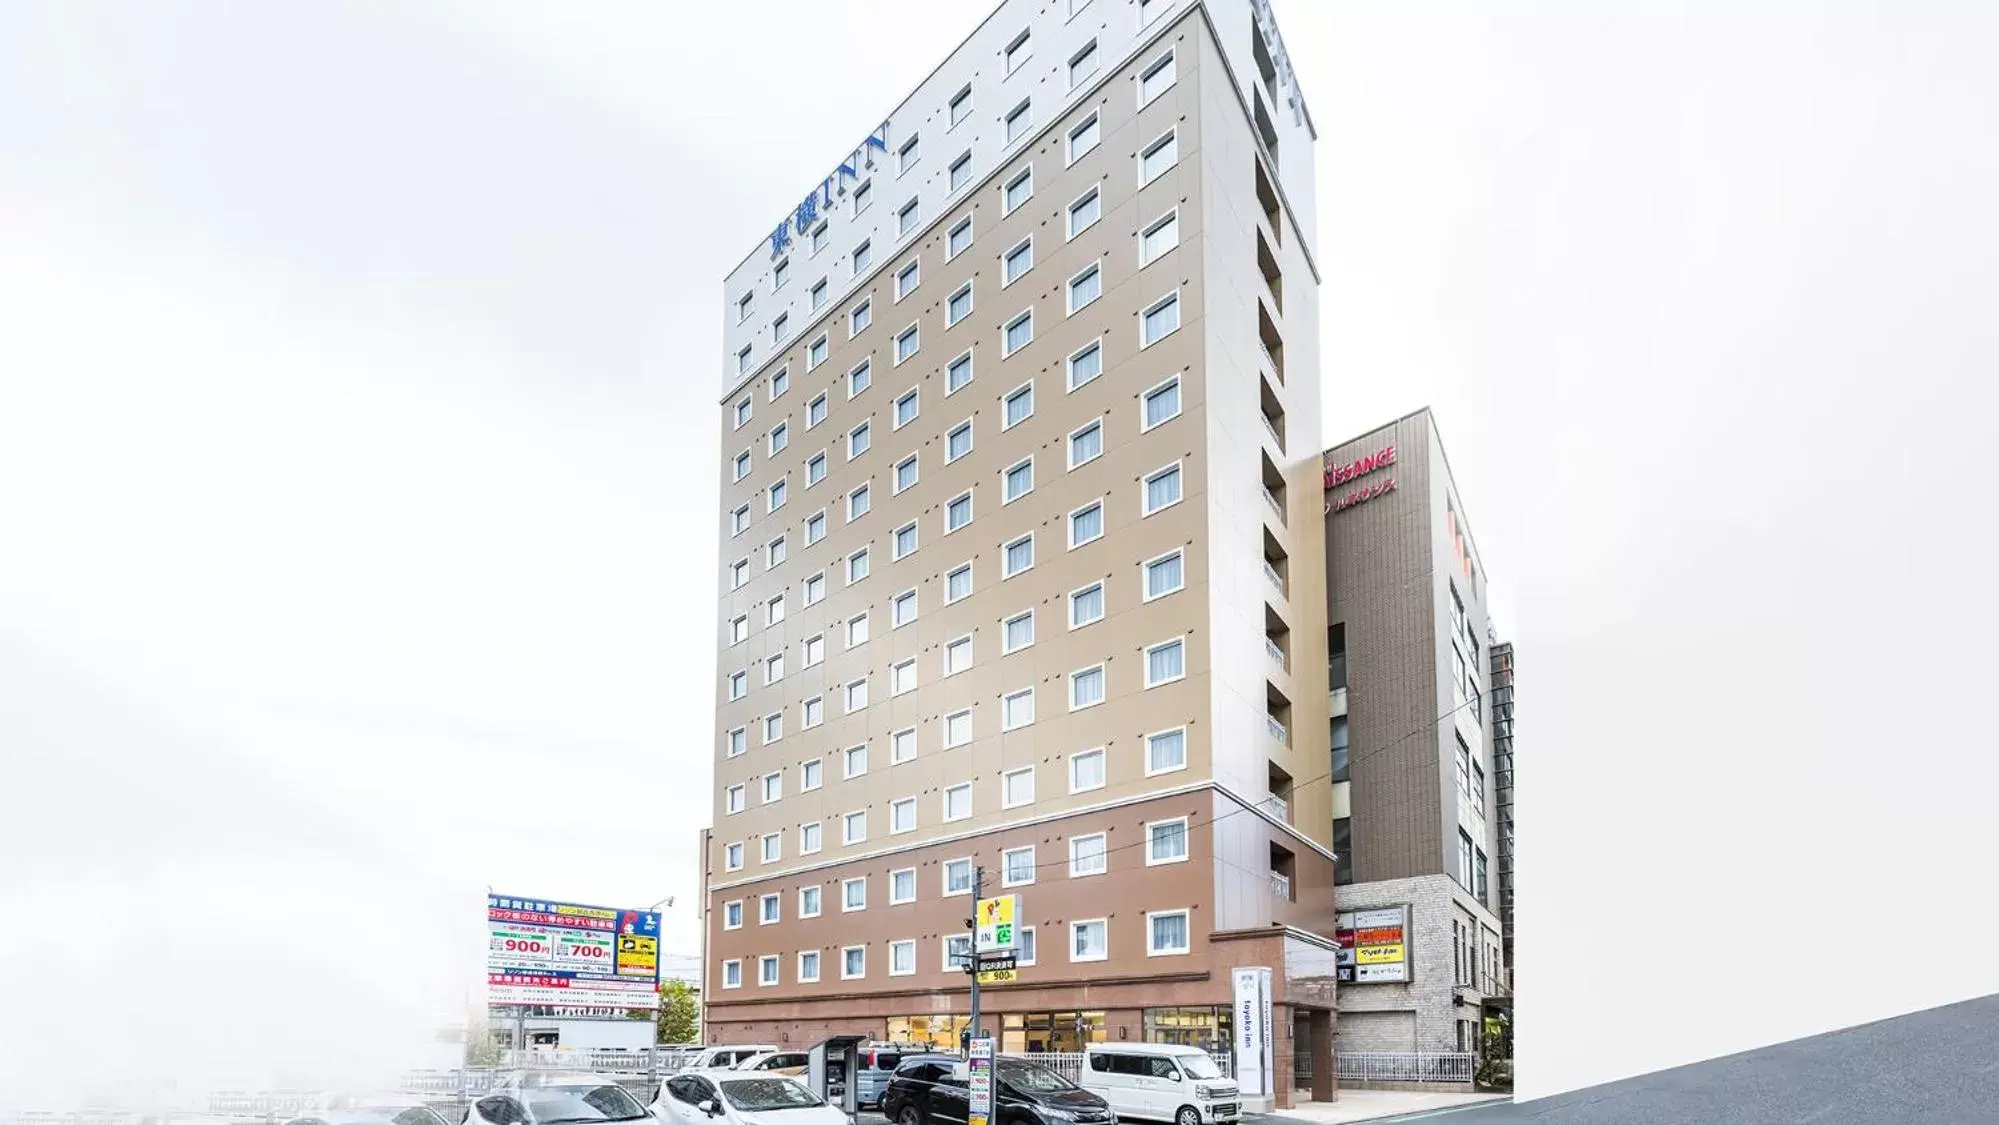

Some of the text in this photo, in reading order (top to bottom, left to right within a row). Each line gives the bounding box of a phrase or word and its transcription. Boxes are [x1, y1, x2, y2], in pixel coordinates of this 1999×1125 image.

[771, 121, 889, 261] 東横INN
[1243, 1000, 1253, 1031] toyoko
[1245, 1034, 1253, 1048] inn
